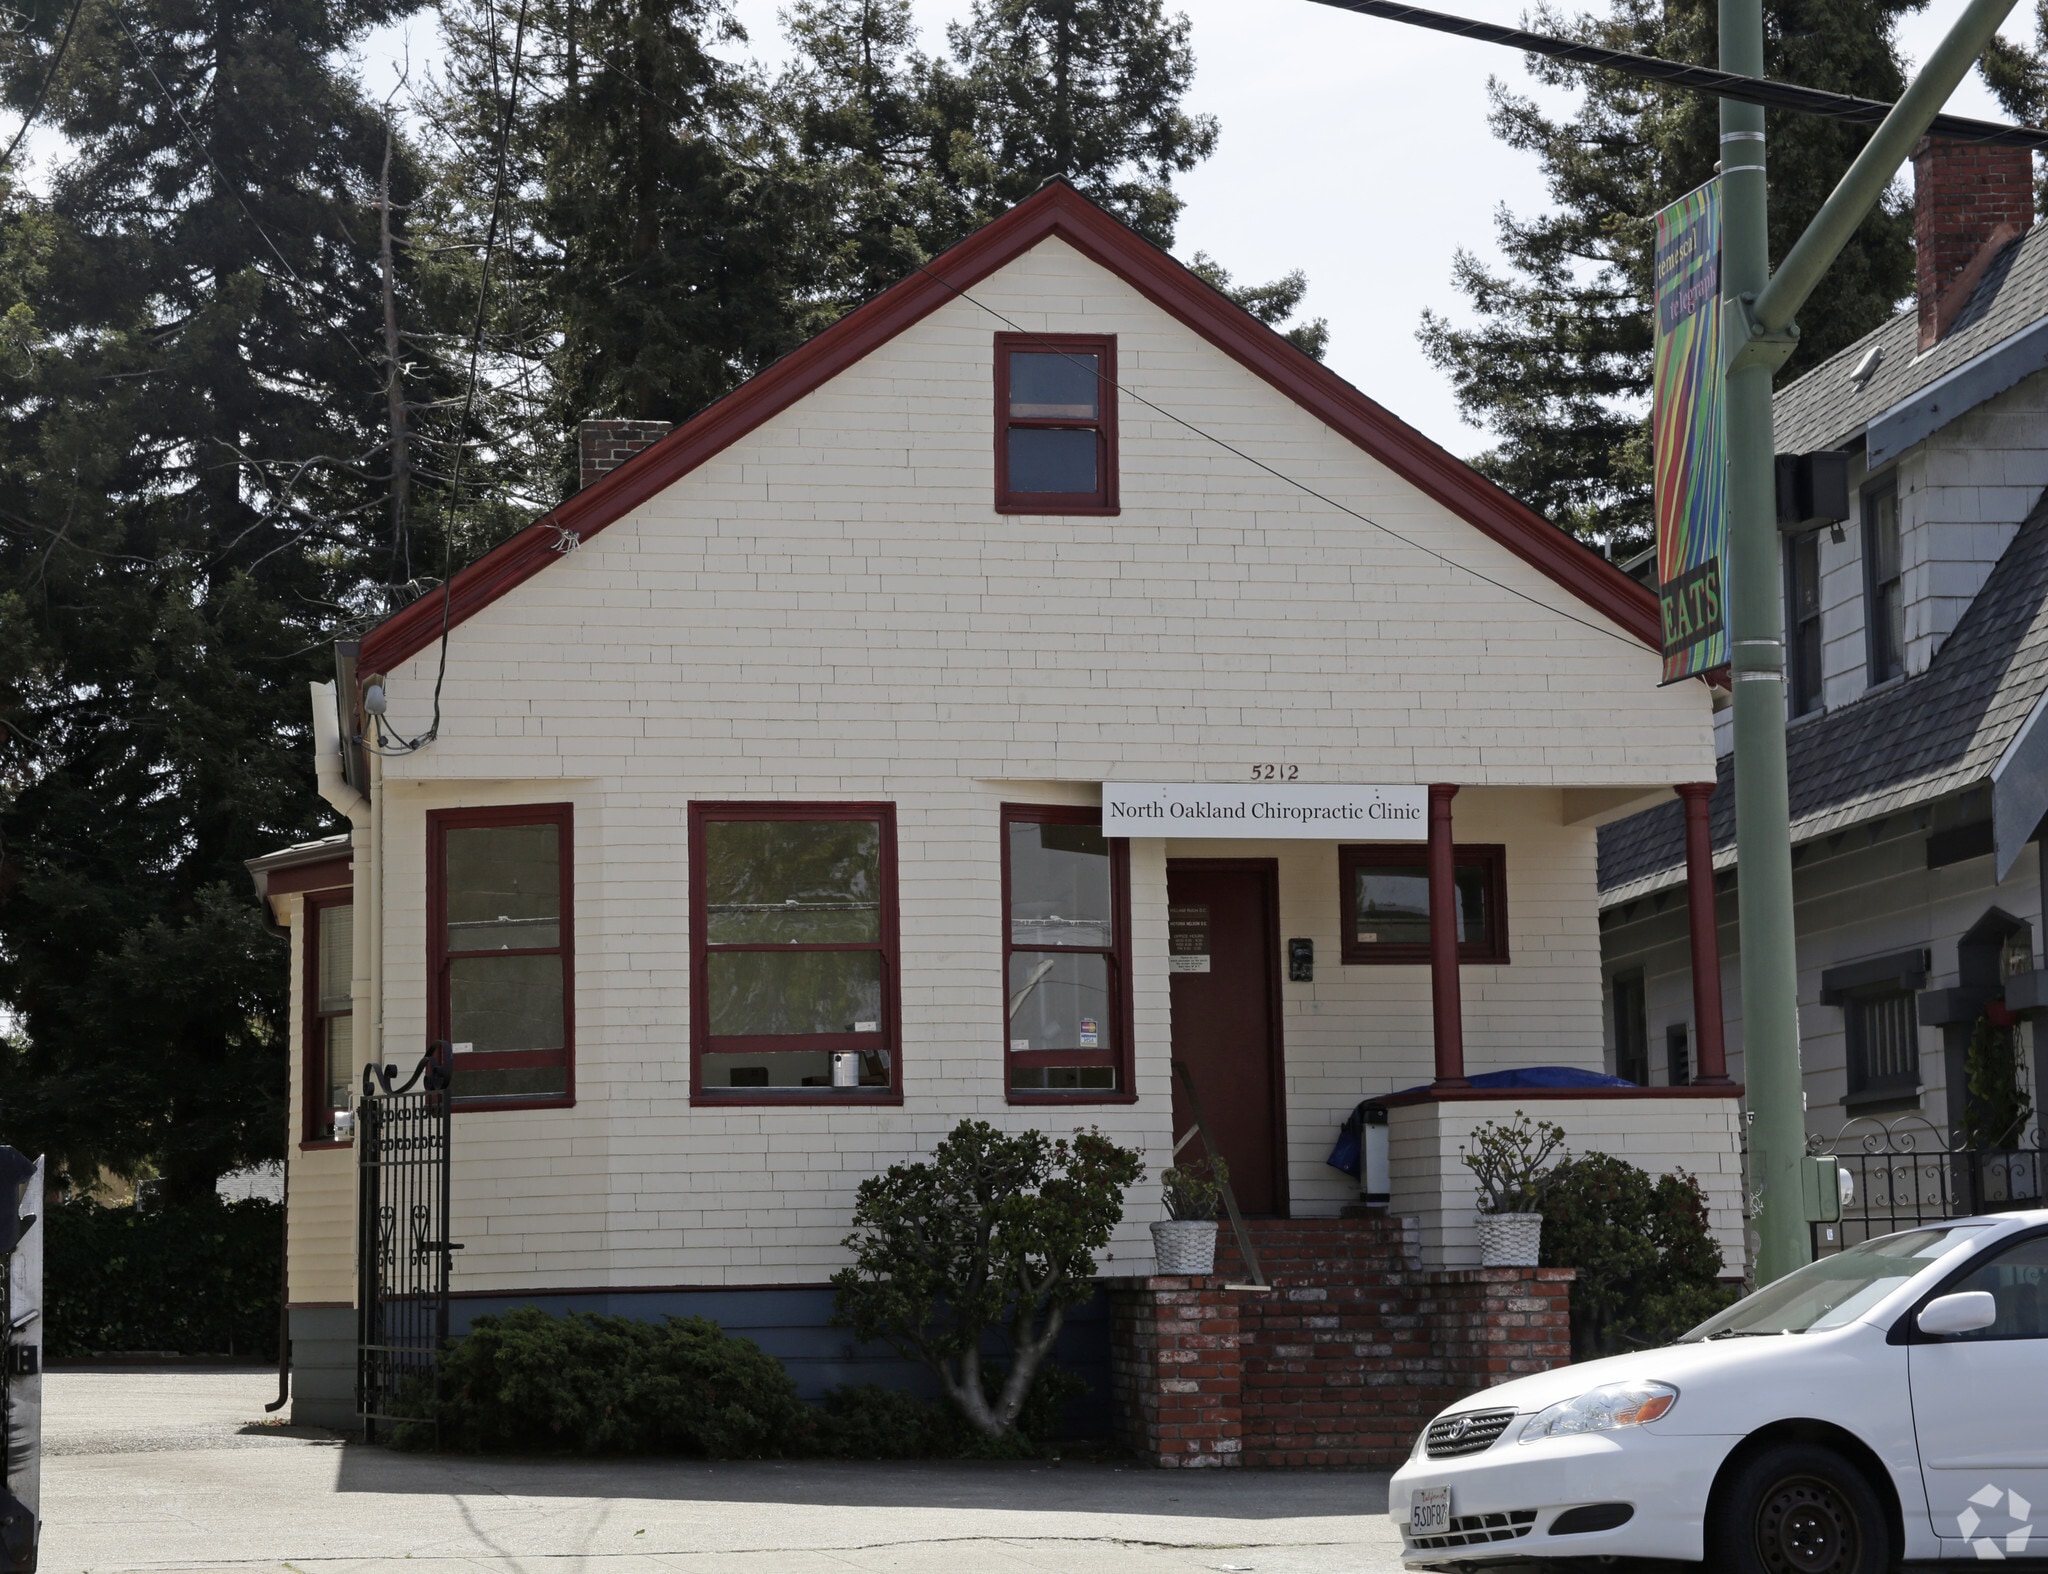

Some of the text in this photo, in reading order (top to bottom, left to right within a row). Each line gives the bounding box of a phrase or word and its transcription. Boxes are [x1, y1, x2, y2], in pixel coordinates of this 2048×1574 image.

[1658, 227, 1697, 279] temescal
[1670, 266, 1716, 320] telegraph
[1661, 571, 1719, 648] EATS
[1250, 763, 1300, 781] 5212
[1110, 802, 1420, 823] North Oakland Chiropractic Clinic
